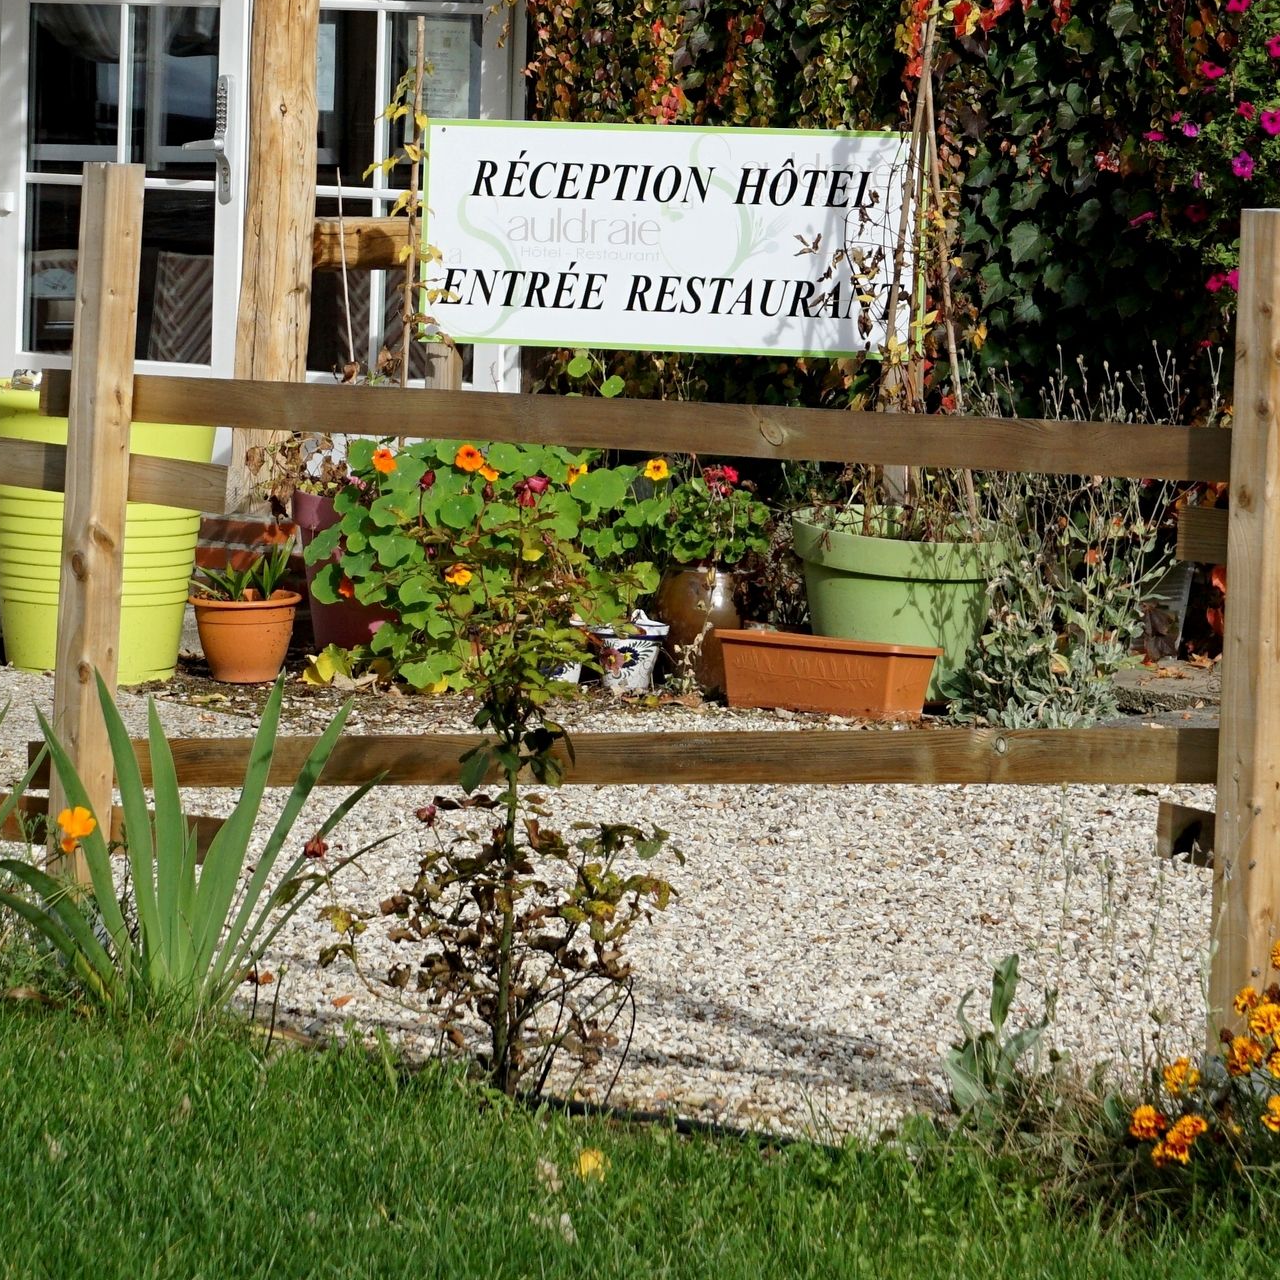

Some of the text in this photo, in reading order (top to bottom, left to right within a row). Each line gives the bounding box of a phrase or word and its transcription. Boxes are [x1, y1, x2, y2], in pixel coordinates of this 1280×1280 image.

[469, 150, 875, 208] RÉCEPTION HÔTEL
[521, 245, 561, 258] Hôtel
[576, 247, 660, 261] Restaurant
[437, 261, 608, 310] ENTRÉE
